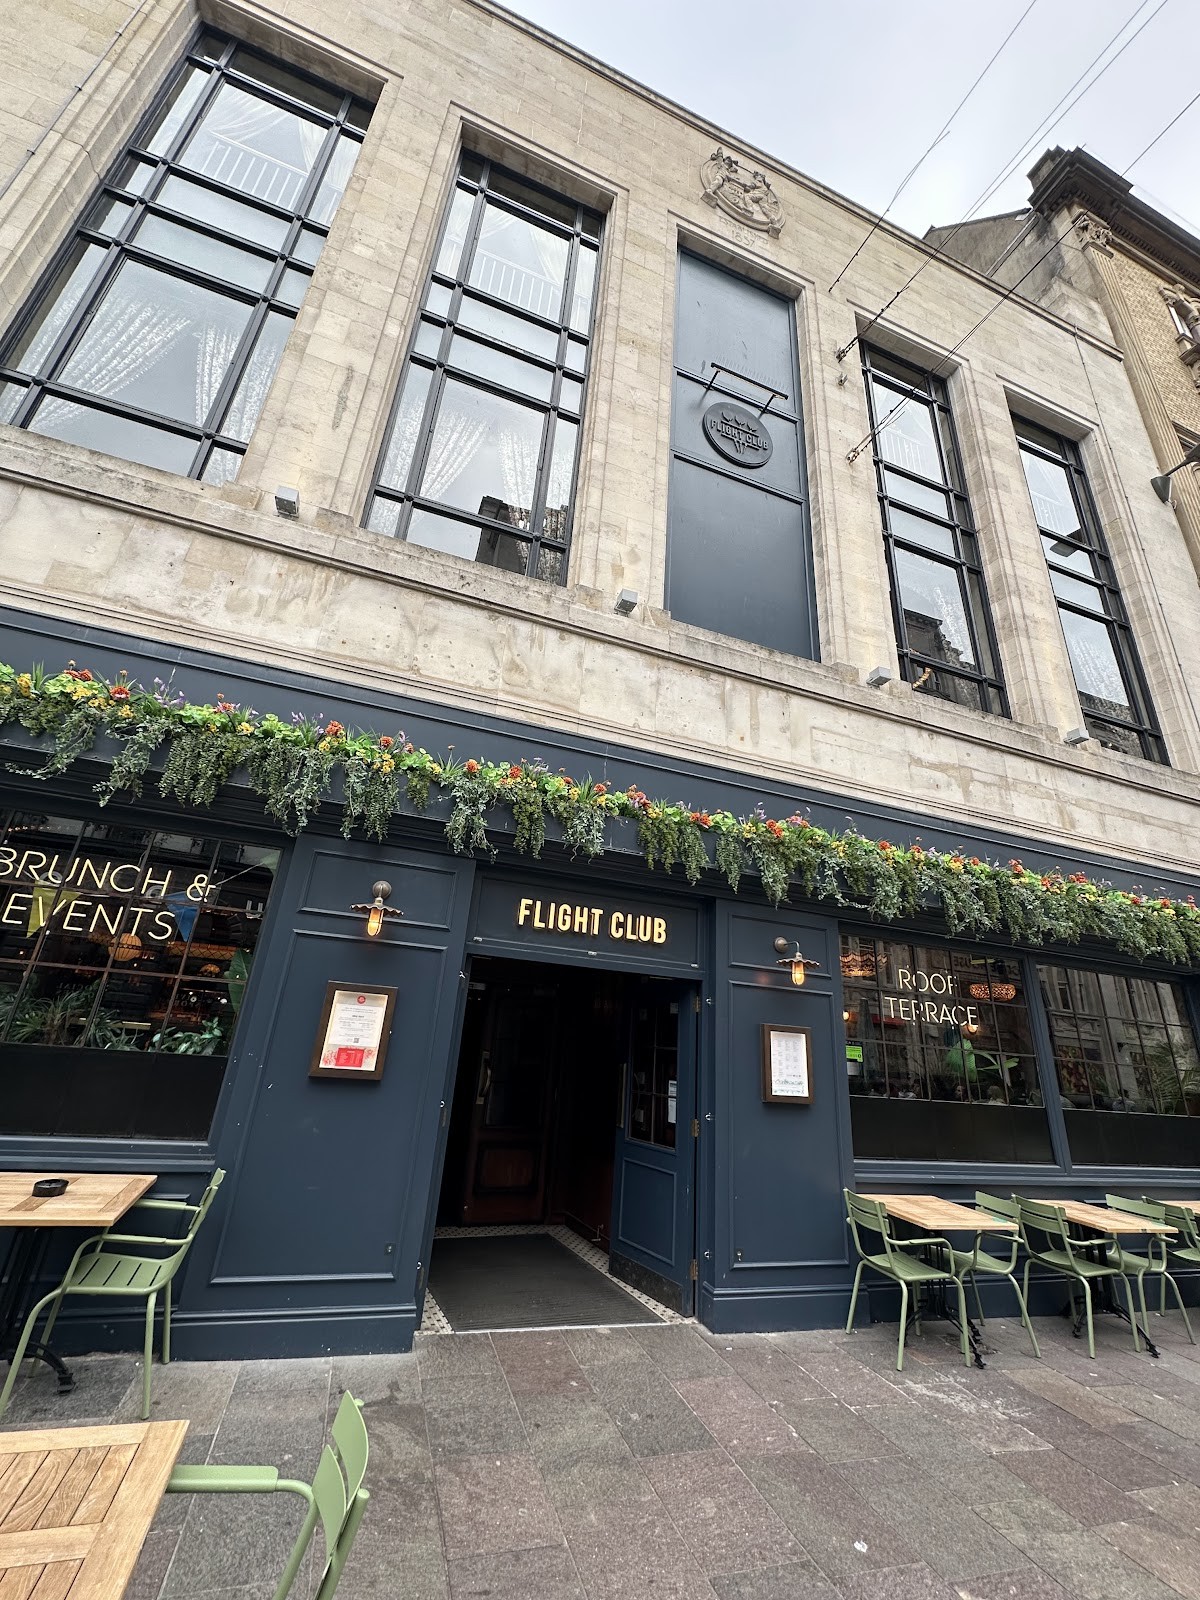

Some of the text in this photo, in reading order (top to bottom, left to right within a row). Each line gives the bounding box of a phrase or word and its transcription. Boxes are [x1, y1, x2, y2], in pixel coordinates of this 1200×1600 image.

[711, 419, 768, 450] FLIGHT CLUB
[0, 846, 216, 902] BRUNCH &
[2, 892, 175, 940] EVENTS
[518, 898, 667, 944] FLIGHT CLUB
[898, 968, 957, 995] ROOF
[884, 996, 978, 1028] TERRACE
